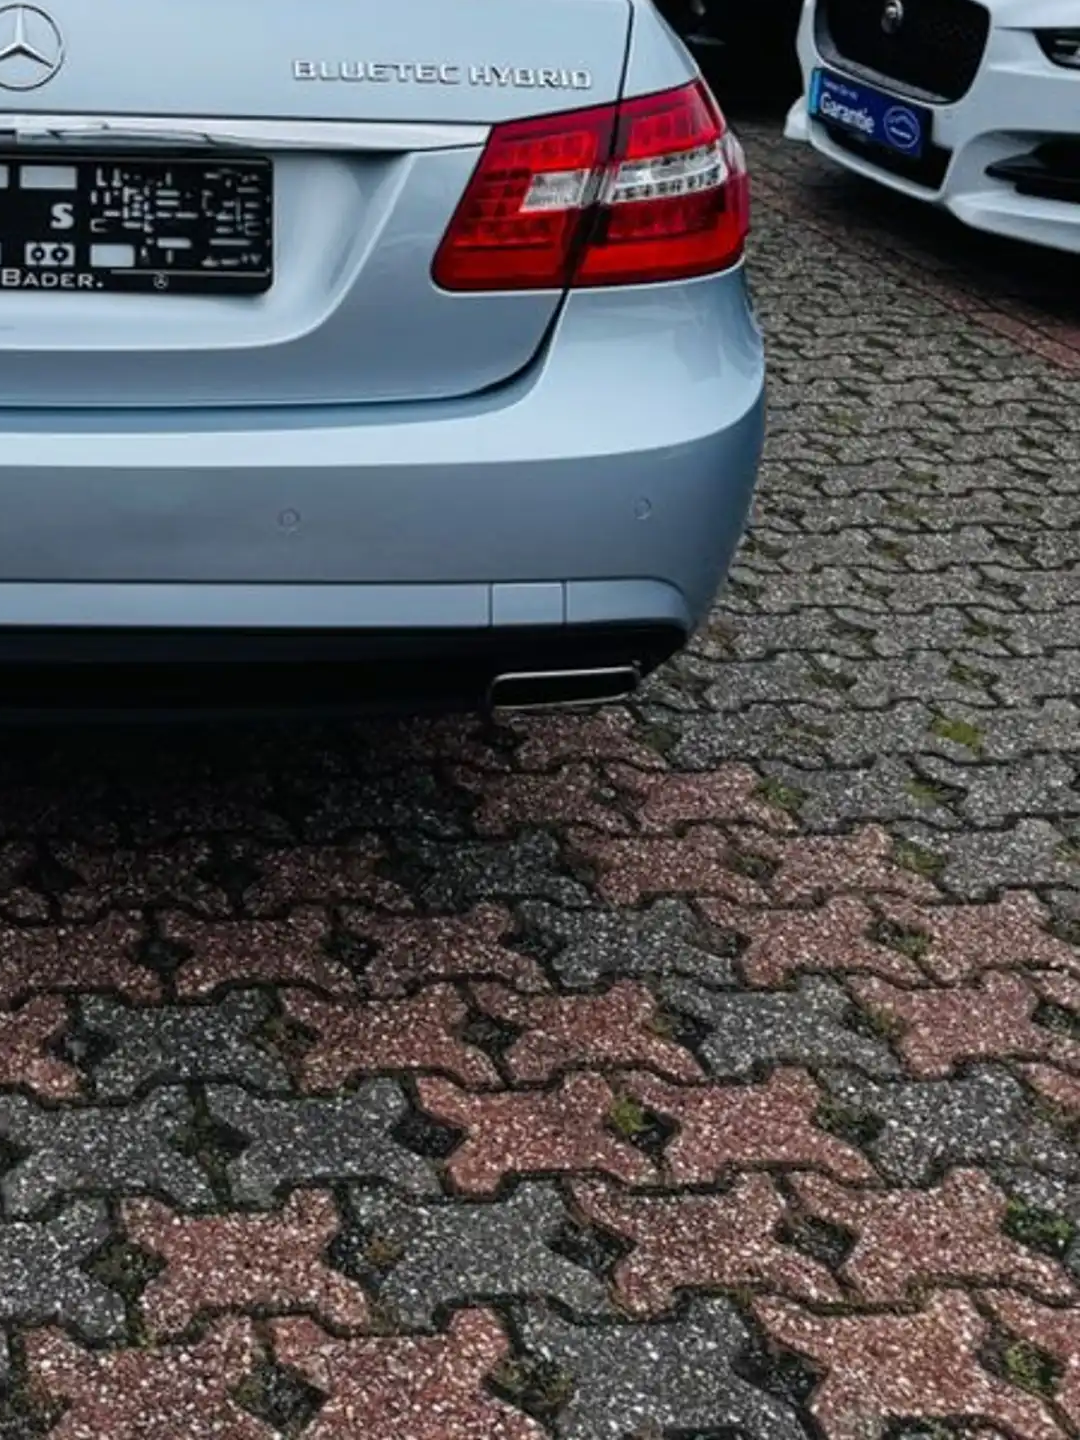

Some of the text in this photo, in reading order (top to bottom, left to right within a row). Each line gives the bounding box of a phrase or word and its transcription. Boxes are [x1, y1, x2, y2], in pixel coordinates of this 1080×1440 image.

[291, 59, 594, 90] BLUETEC HYBRID
[50, 202, 75, 229] S
